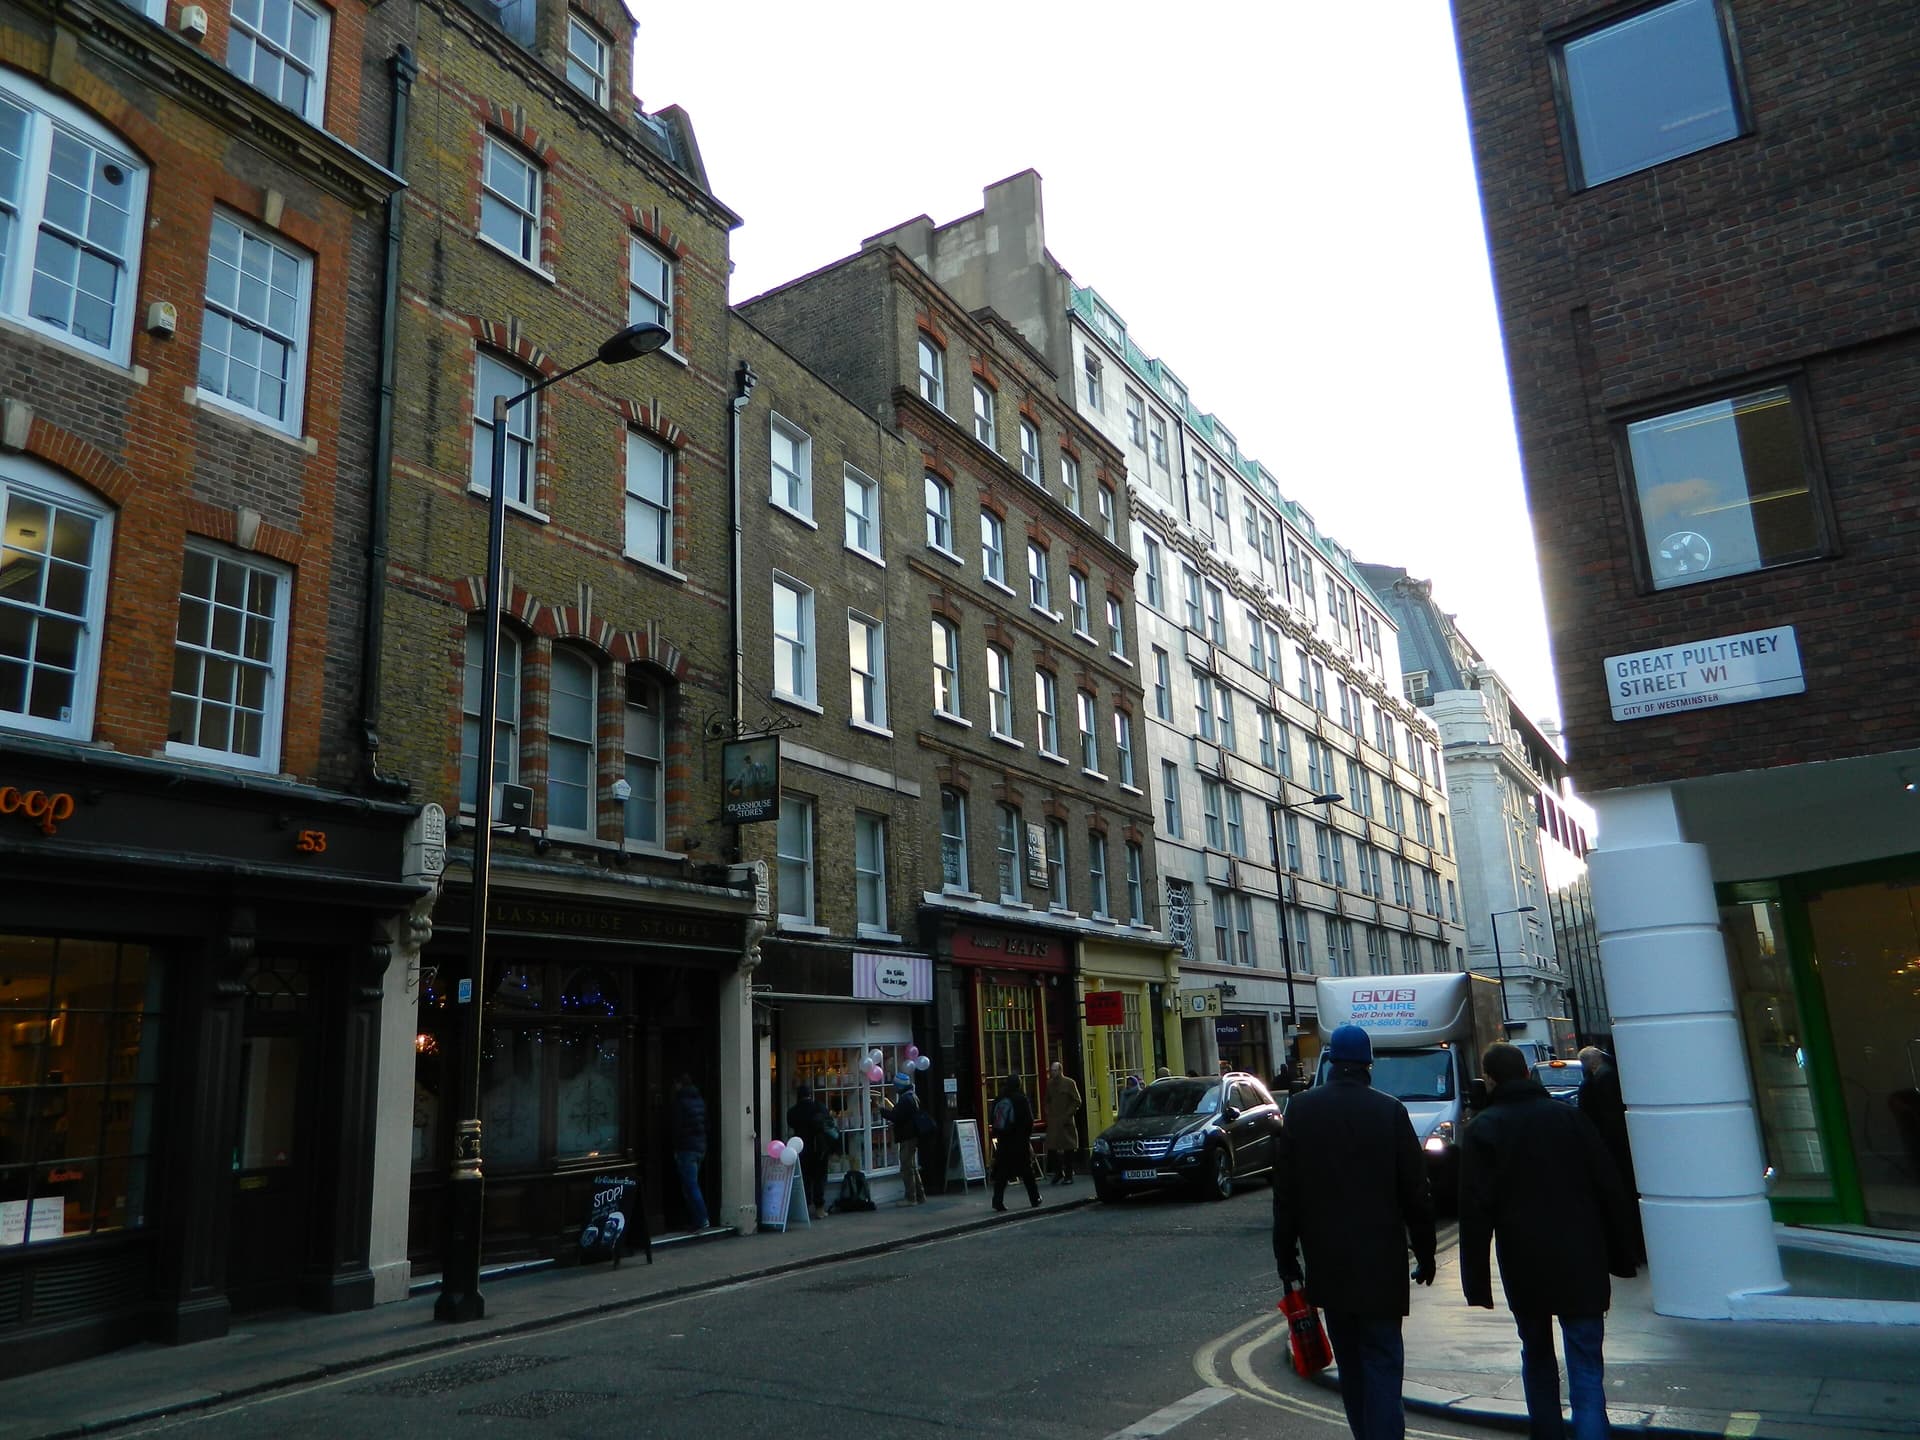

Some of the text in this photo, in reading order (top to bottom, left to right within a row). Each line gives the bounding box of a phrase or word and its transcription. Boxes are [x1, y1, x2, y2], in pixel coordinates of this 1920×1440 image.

[1616, 635, 1778, 678] GREAT PULTENEY
[1620, 665, 1728, 697] STREET W1
[1623, 694, 1719, 716] CITY OF WESTMINSTER
[728, 799, 772, 812] GLASSHOUSE
[736, 809, 763, 818] STORES
[298, 830, 327, 852] 53
[488, 905, 624, 930] LASSHOUSE
[1351, 1002, 1416, 1011] VAN HIRE
[1353, 990, 1415, 1002] CVS
[1216, 1025, 1239, 1033] relax
[594, 1184, 623, 1208] STOP!
